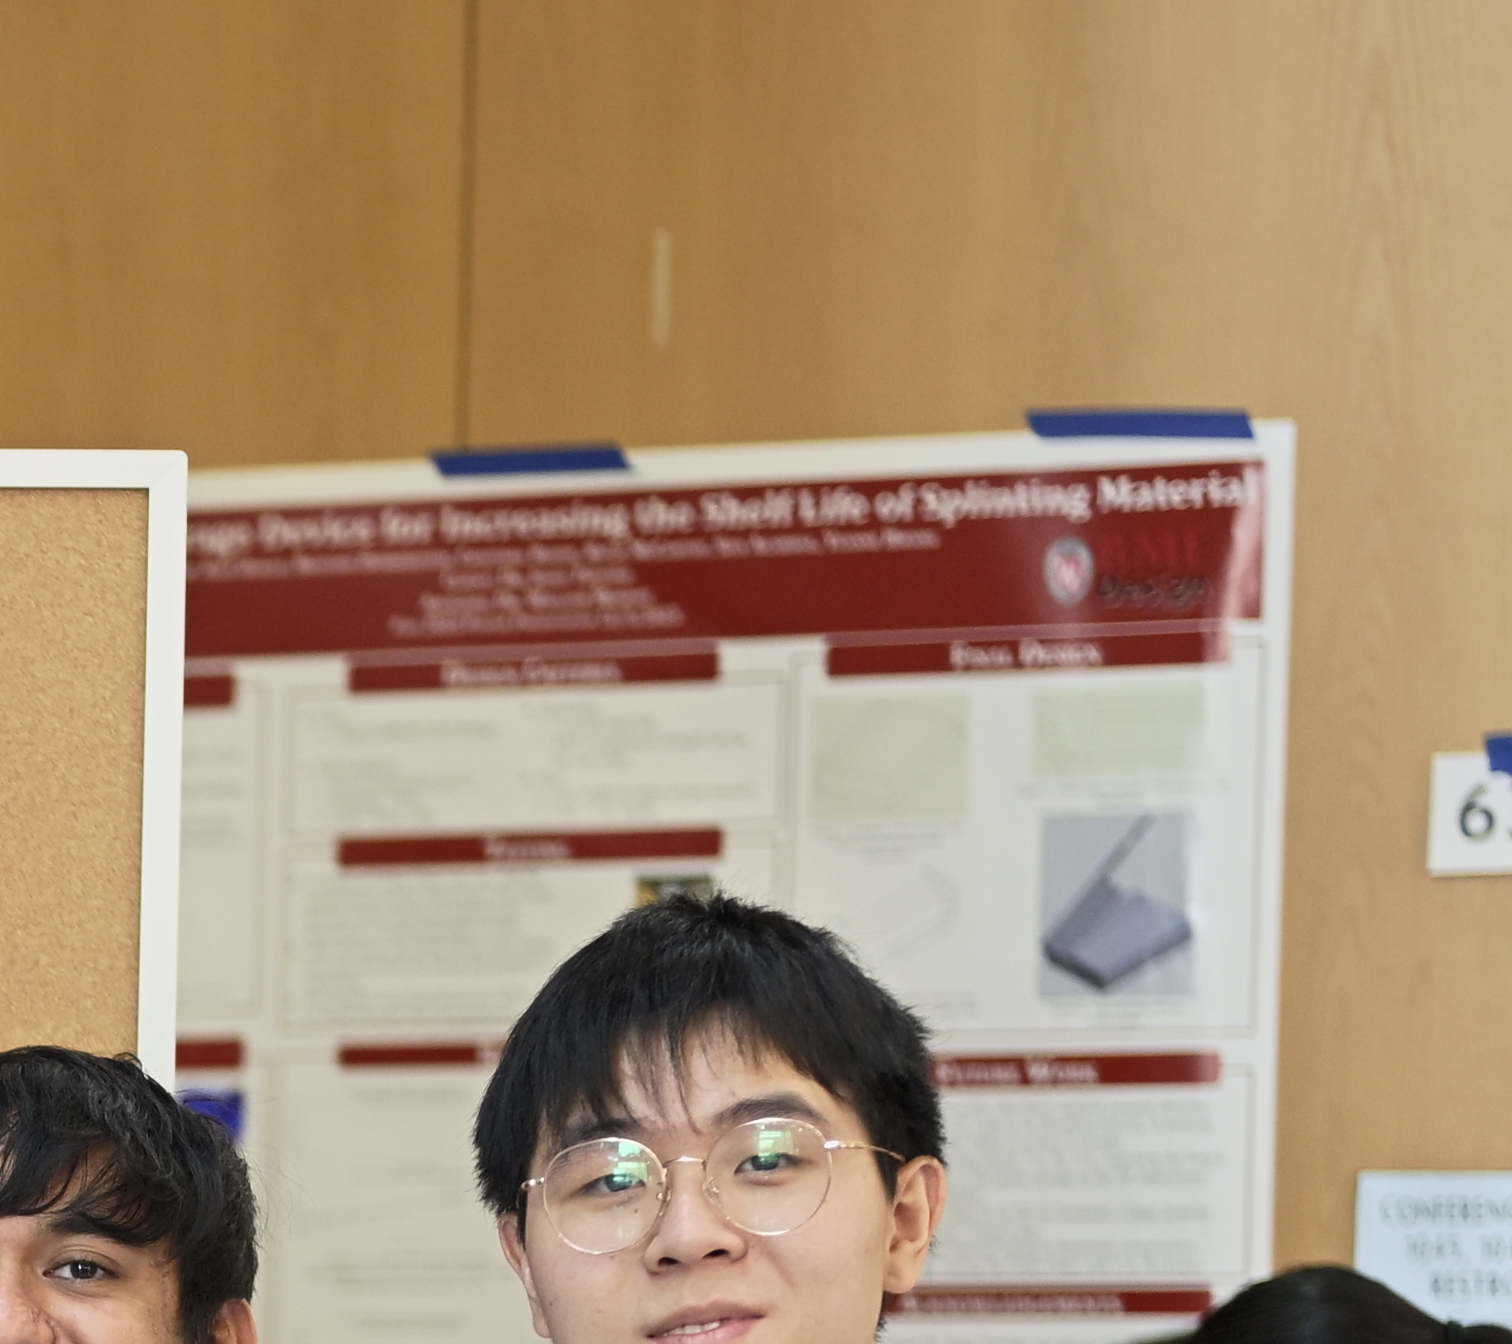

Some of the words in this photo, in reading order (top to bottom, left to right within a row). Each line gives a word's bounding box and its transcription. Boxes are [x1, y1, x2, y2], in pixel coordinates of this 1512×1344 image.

[439, 500, 629, 546] Increasing
[634, 495, 697, 536] the
[700, 483, 795, 532] Shelf
[799, 485, 866, 526] Life
[875, 482, 919, 524] of
[921, 476, 1091, 526] Splinting
[1096, 468, 1255, 514] Material
[1459, 783, 1510, 842] 6
